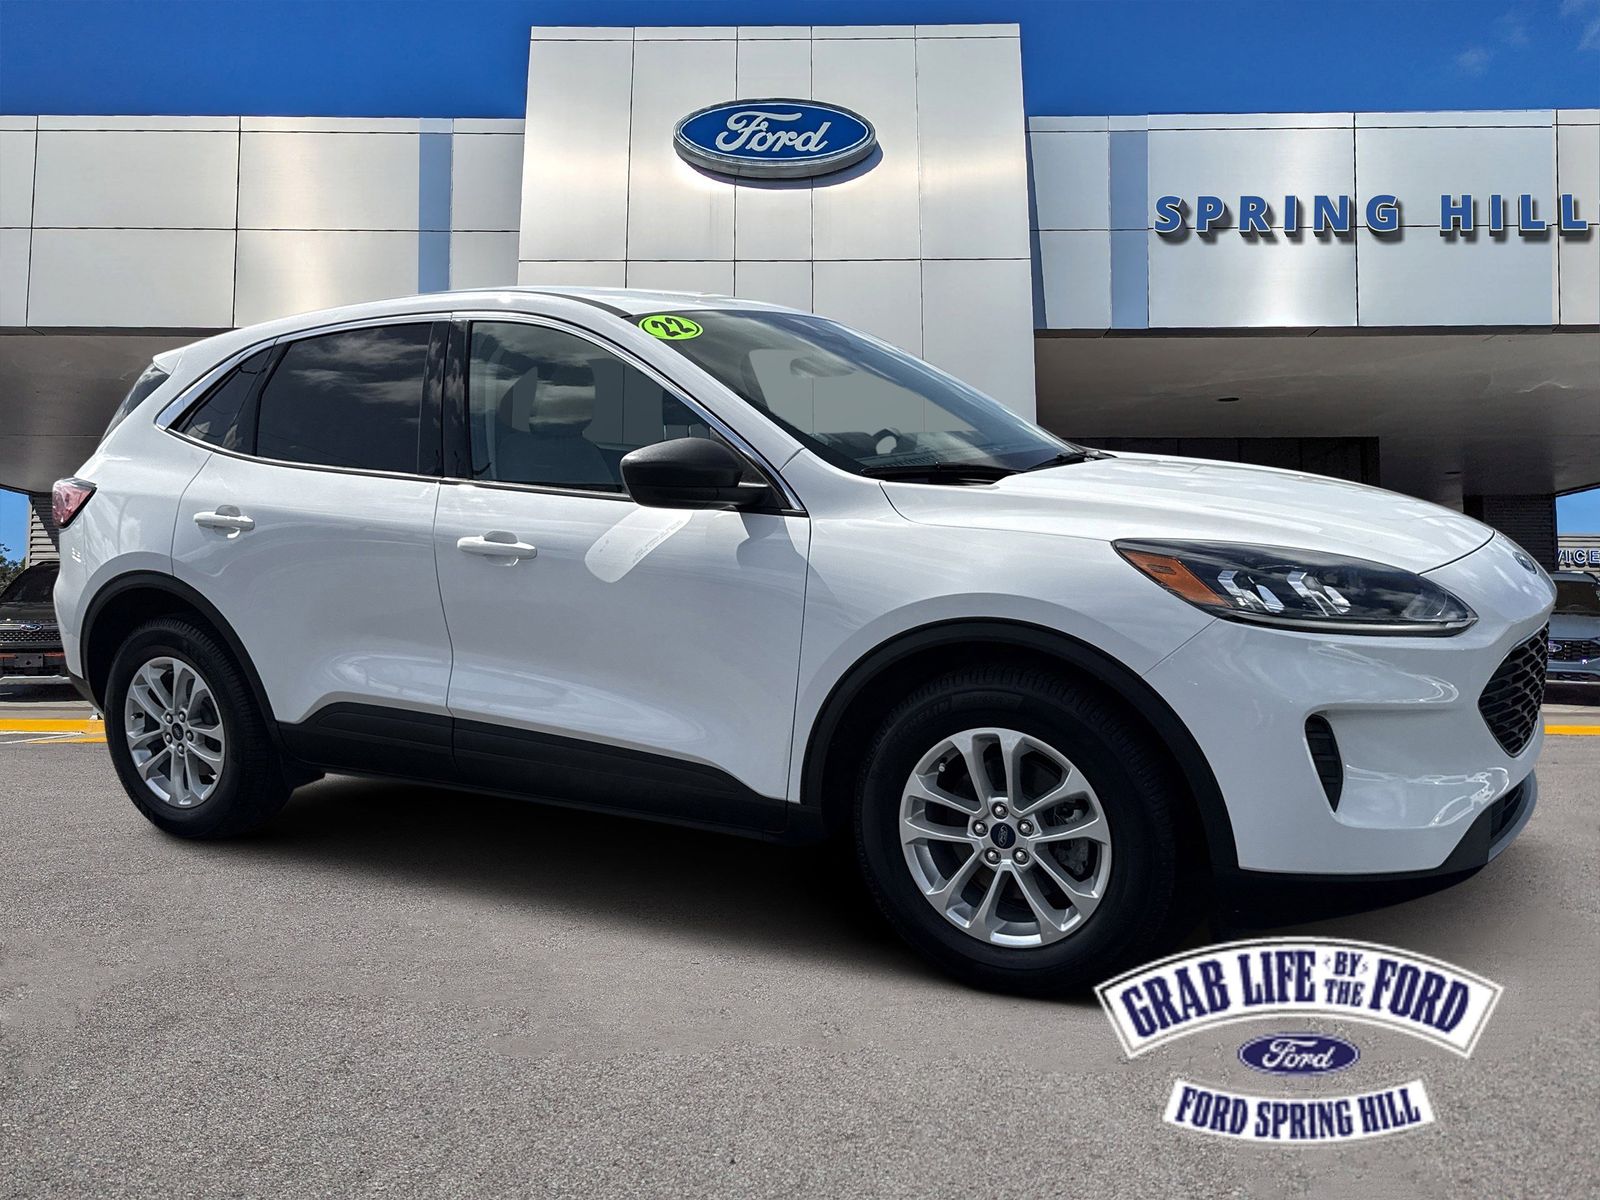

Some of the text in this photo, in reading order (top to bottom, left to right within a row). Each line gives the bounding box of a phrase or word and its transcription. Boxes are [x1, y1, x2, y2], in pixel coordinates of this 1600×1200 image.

[715, 111, 832, 152] Ford
[1154, 194, 1589, 232] SPRING HILL
[651, 317, 695, 337] 22
